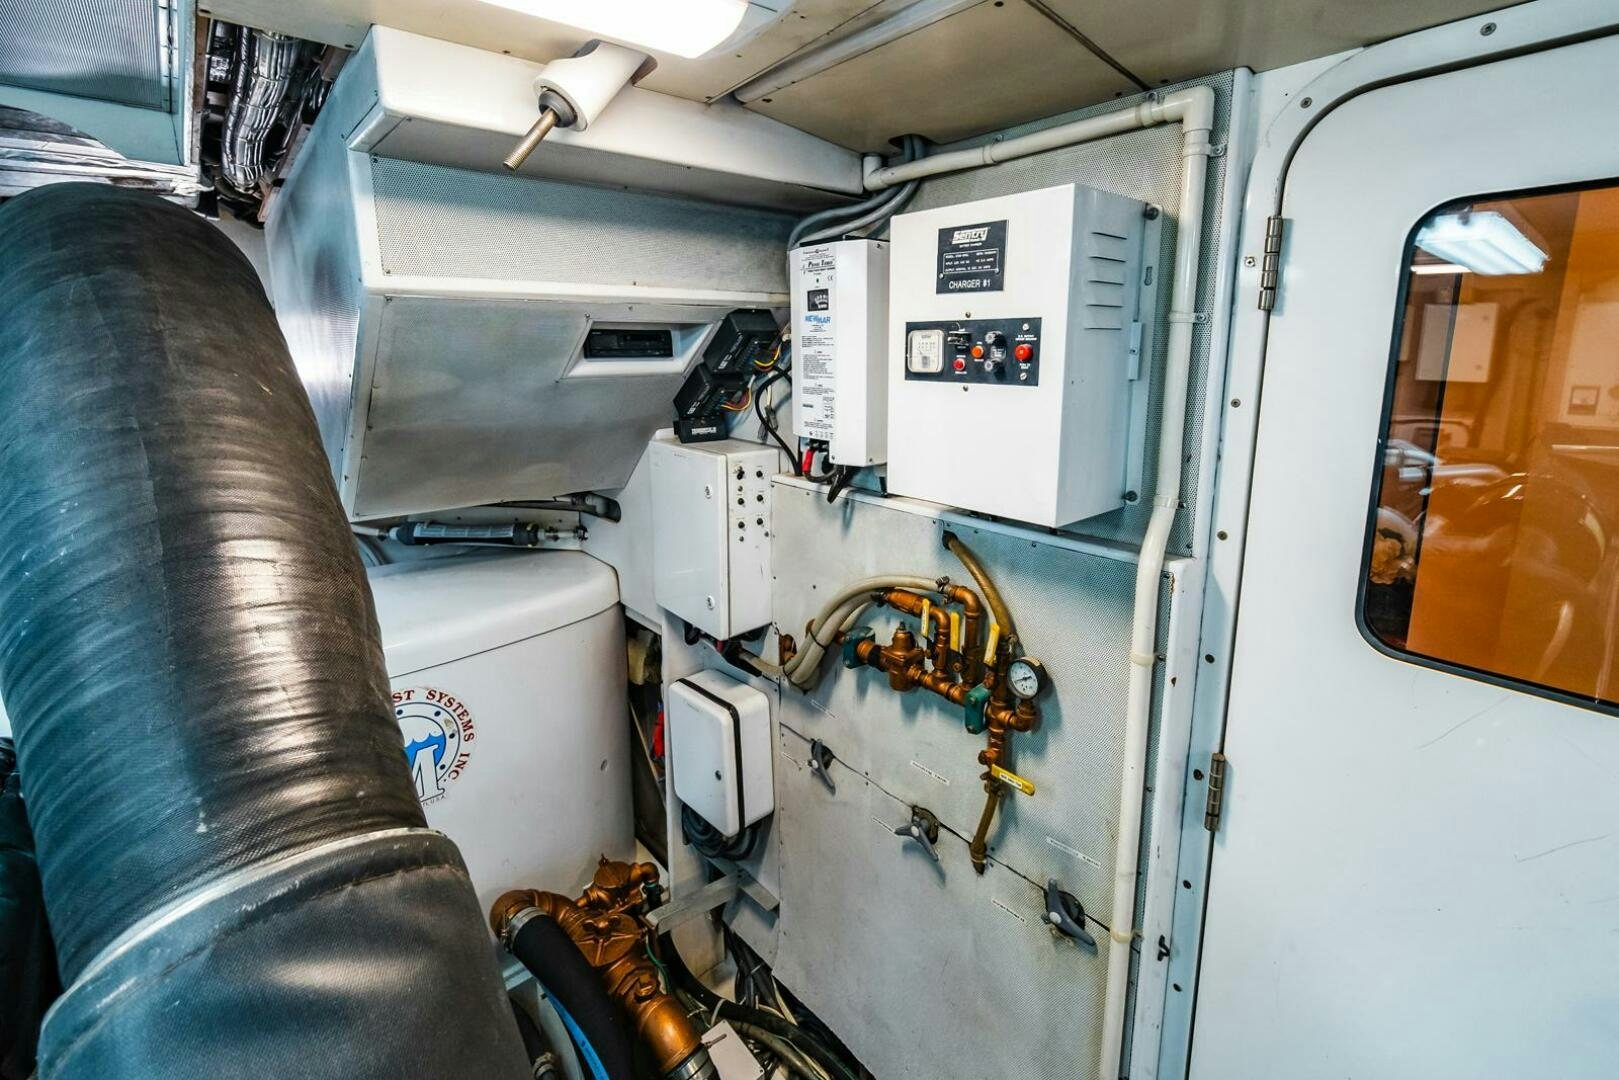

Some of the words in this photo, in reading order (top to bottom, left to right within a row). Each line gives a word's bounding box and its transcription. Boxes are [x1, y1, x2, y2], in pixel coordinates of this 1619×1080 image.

[949, 279, 981, 289] CHARGER
[392, 690, 414, 703] ST
[426, 689, 475, 742] SYSTEMS
